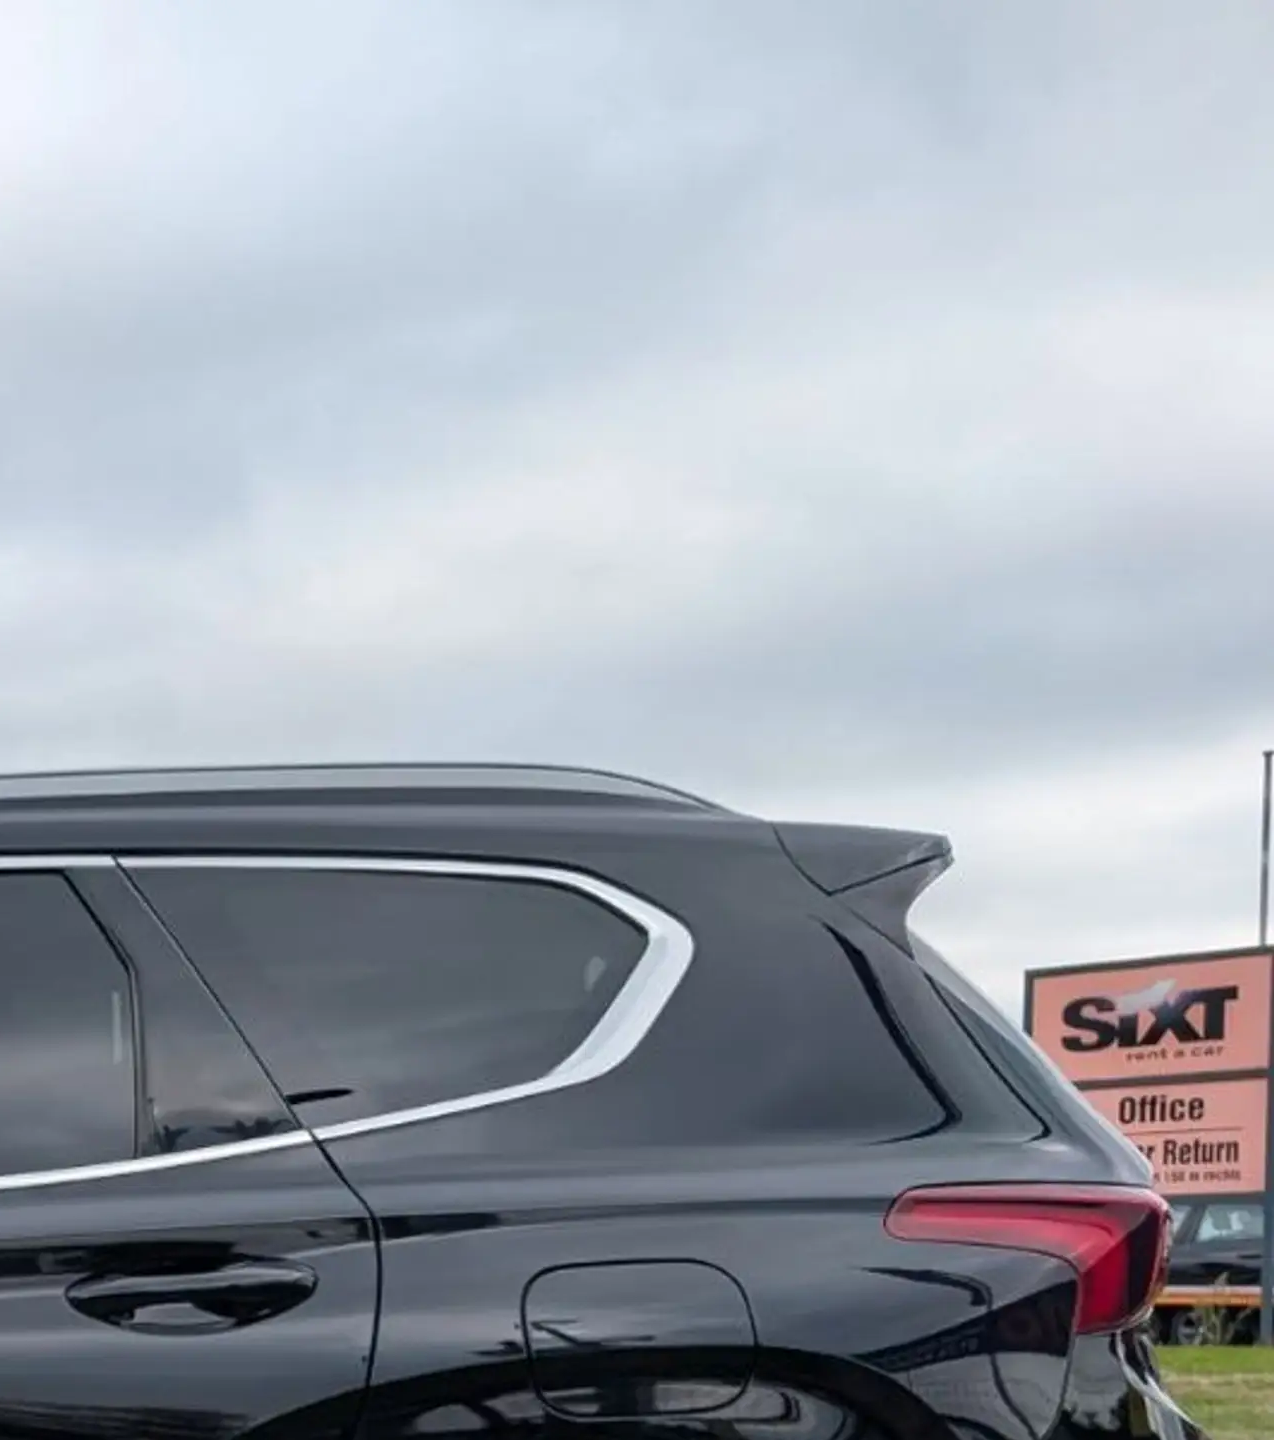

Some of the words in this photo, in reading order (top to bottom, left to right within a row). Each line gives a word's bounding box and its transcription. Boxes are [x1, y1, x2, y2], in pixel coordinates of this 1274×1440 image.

[1125, 1049, 1167, 1061] rent
[1173, 1050, 1184, 1059] a
[1190, 1046, 1224, 1057] car
[1119, 1094, 1204, 1124] Office
[1162, 1138, 1239, 1165] Return
